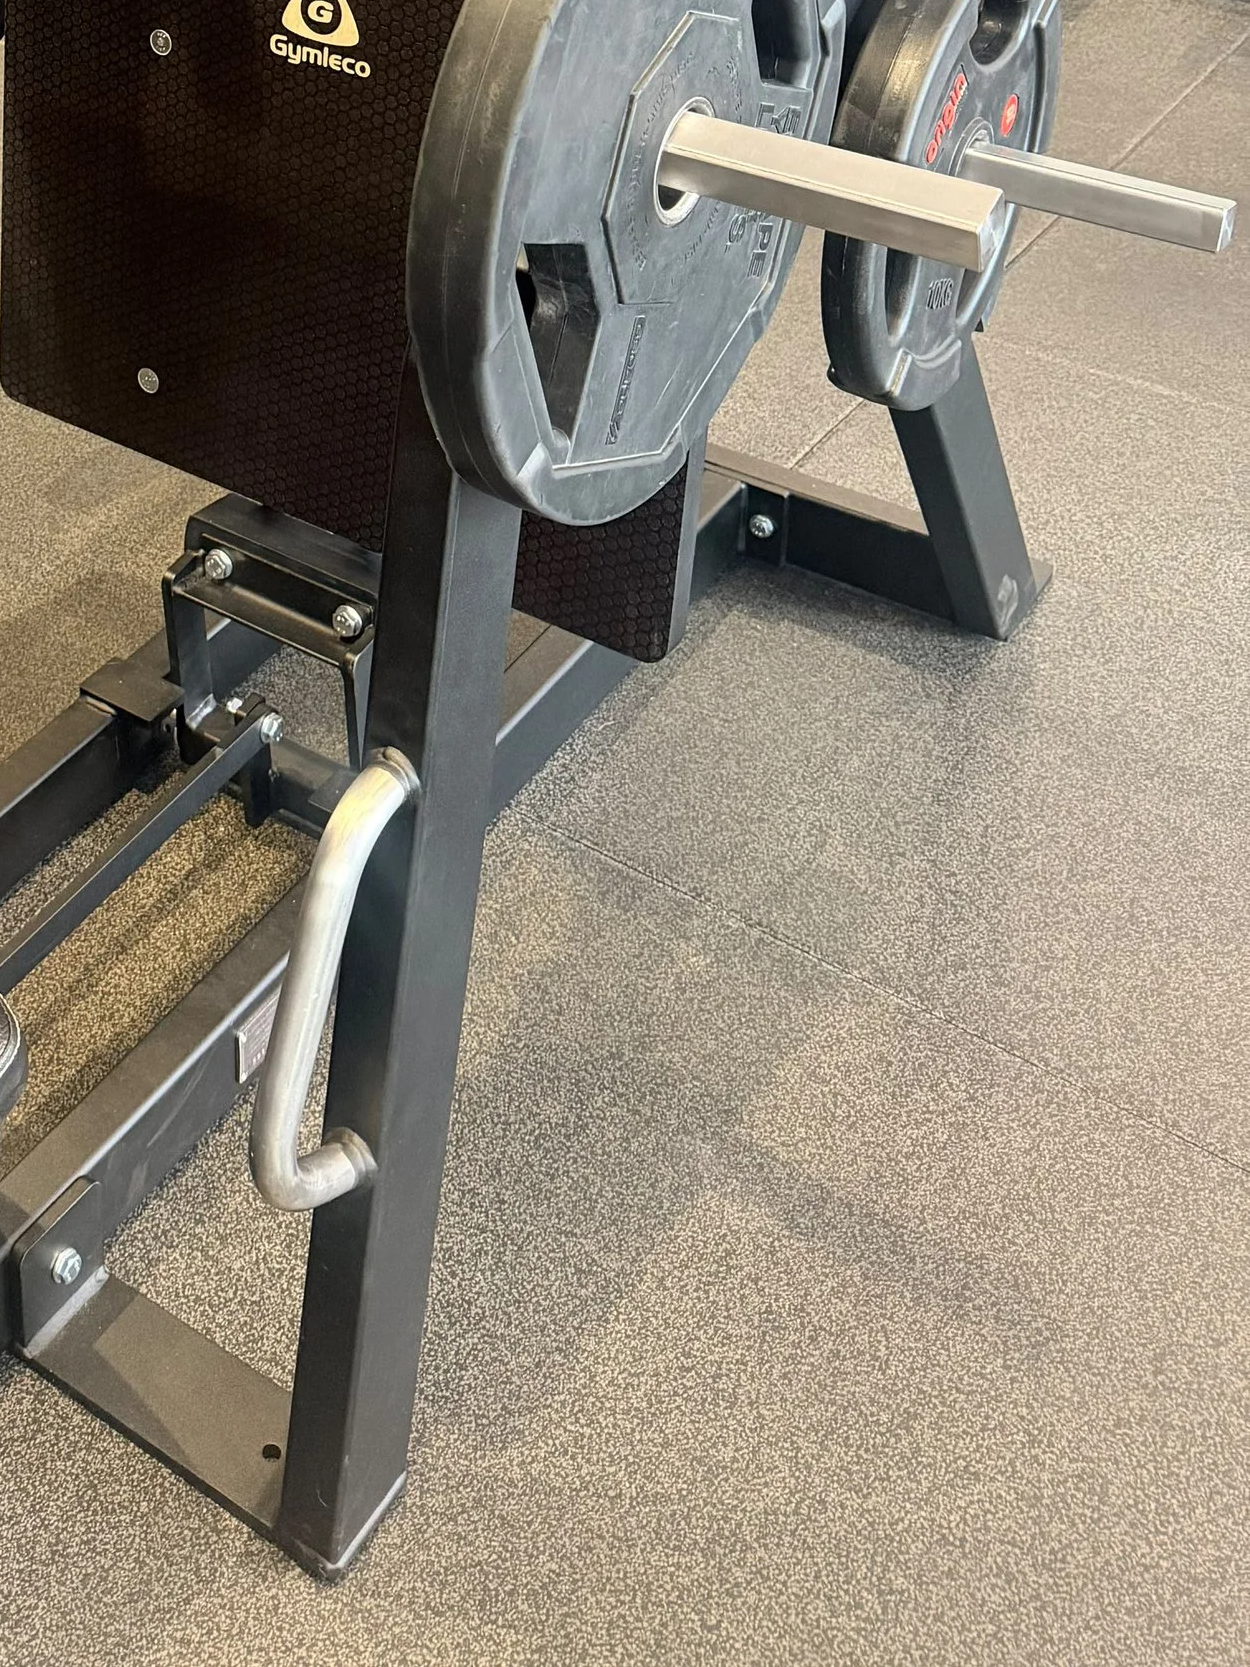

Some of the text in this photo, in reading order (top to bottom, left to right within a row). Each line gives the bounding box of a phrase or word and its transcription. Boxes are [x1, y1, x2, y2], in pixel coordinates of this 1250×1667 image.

[307, 0, 334, 24] G
[270, 33, 371, 78] Gymleco
[925, 72, 968, 165] origin
[925, 277, 954, 311] 10KG
